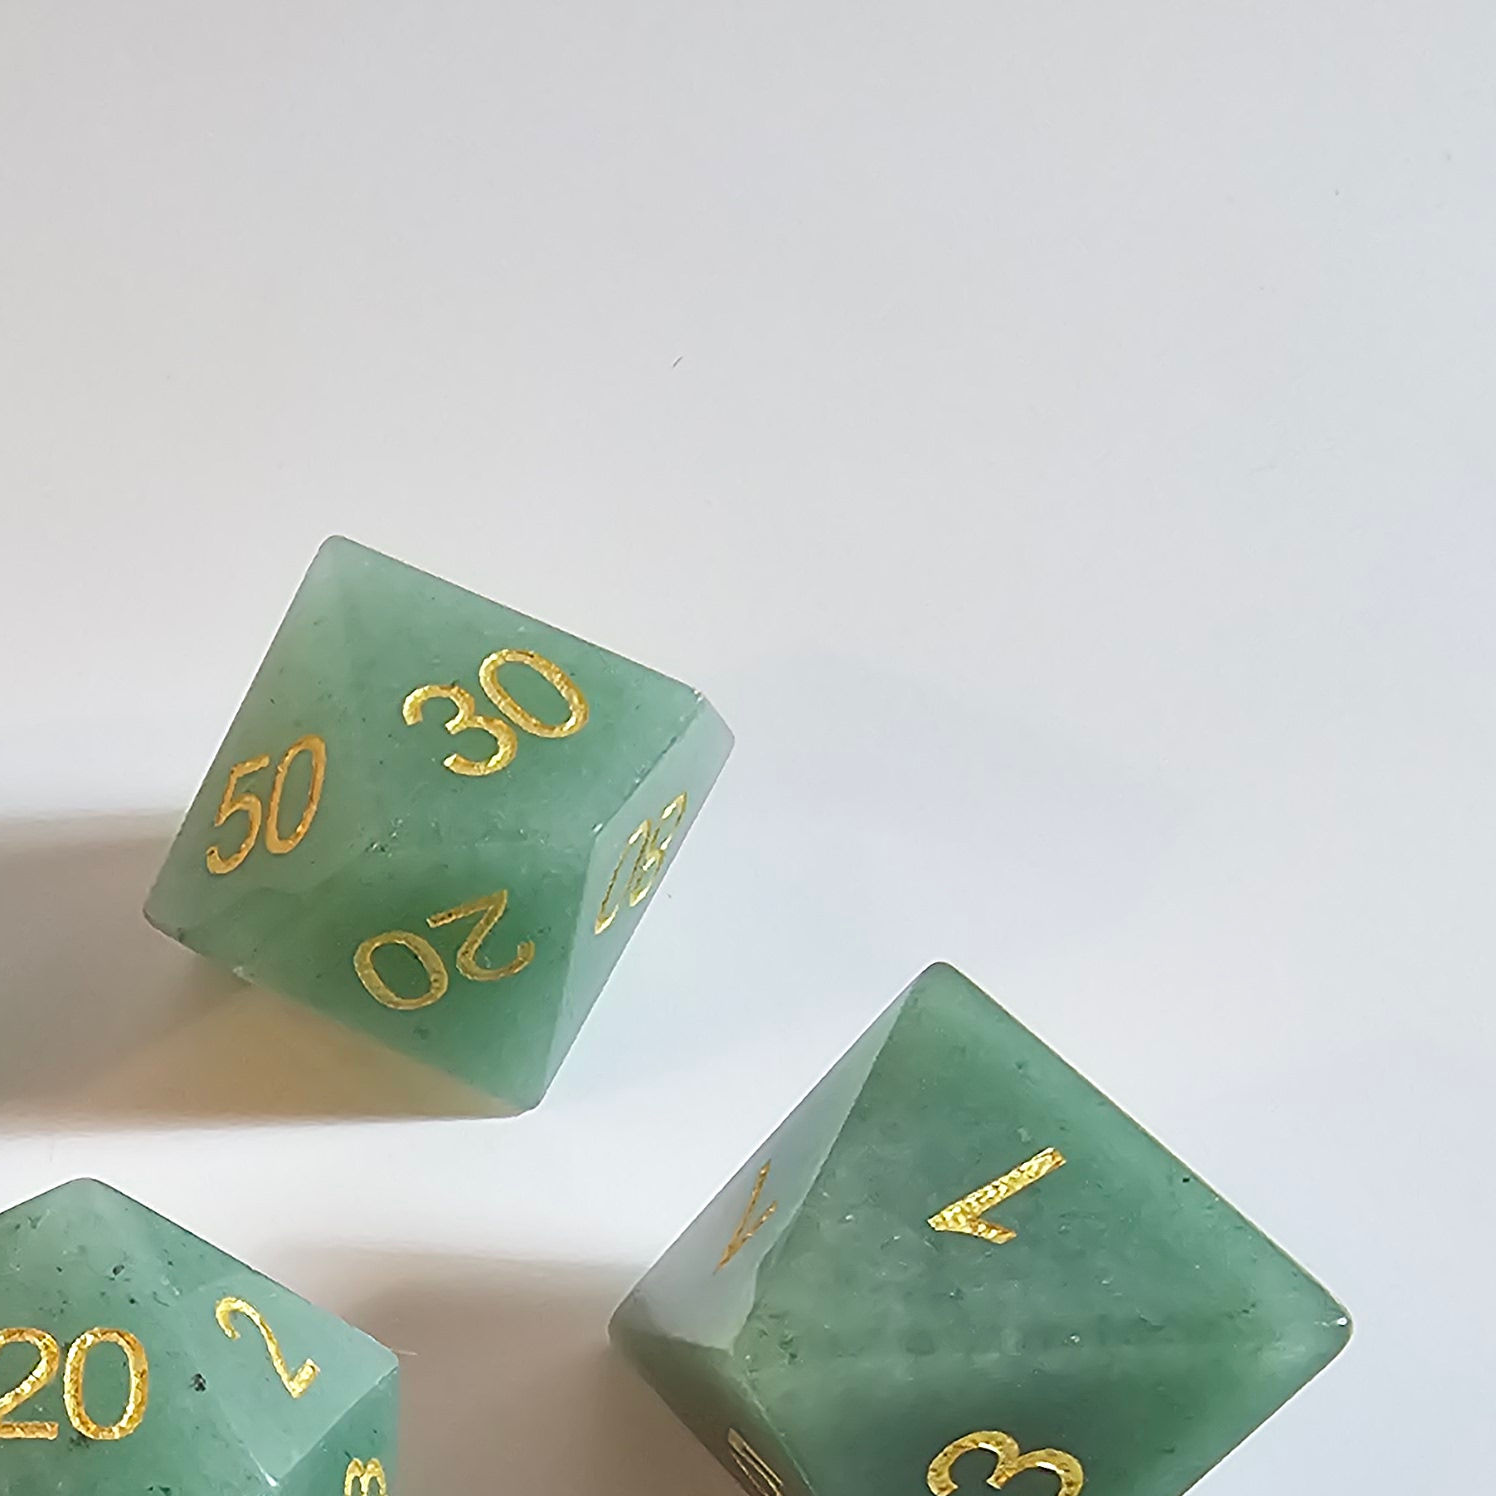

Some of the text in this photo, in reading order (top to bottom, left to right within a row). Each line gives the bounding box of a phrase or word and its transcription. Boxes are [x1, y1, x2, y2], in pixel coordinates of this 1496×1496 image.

[403, 649, 589, 776] 30
[206, 734, 326, 874] 50
[356, 891, 533, 1010] 20
[215, 1296, 320, 1398] 2
